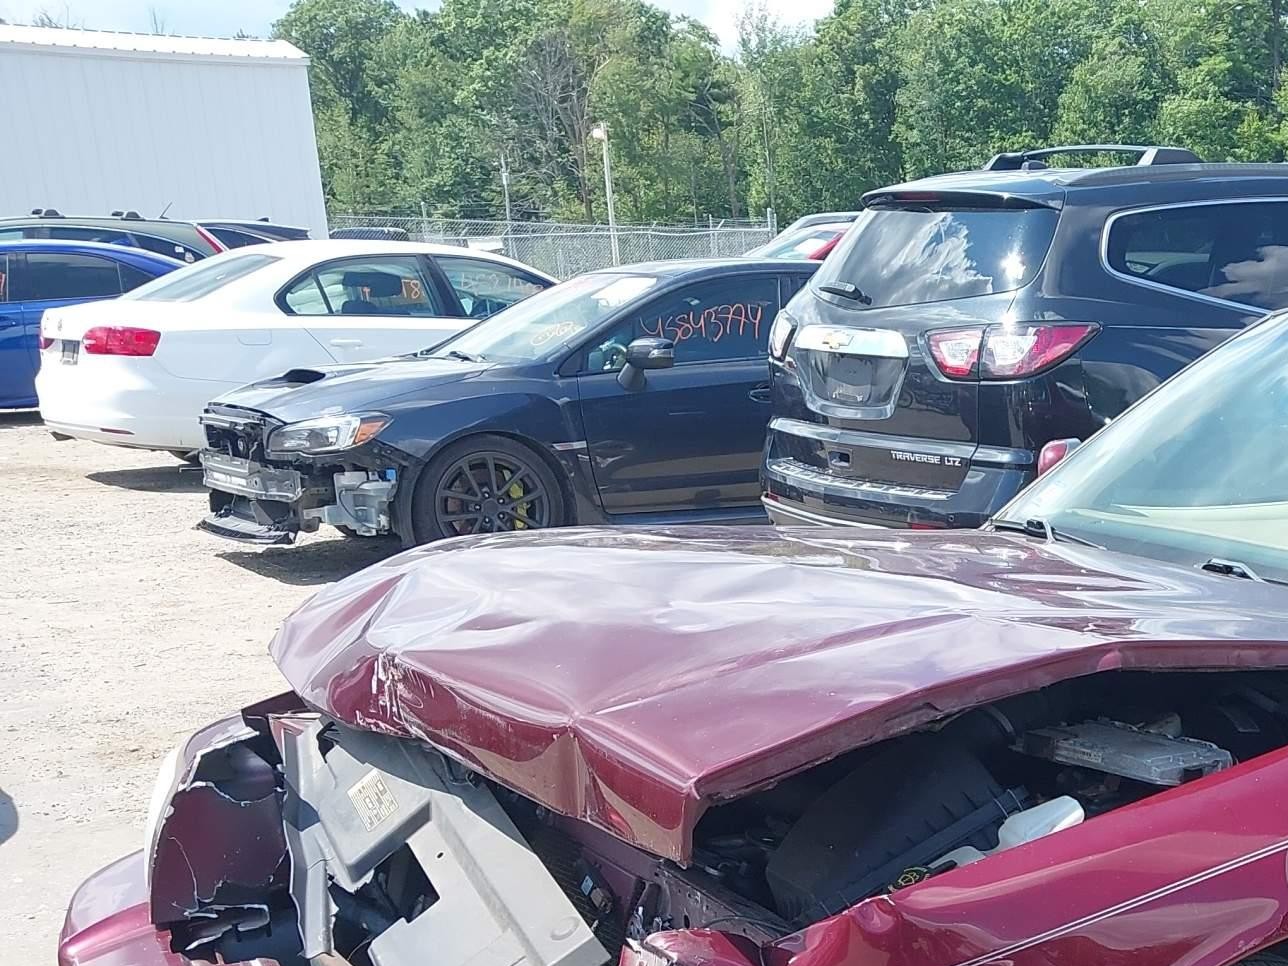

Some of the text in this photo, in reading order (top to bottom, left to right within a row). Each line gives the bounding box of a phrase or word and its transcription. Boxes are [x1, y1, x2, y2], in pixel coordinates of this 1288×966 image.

[639, 303, 762, 345] 45843774
[891, 450, 961, 466] TRAVERSE LTZ
